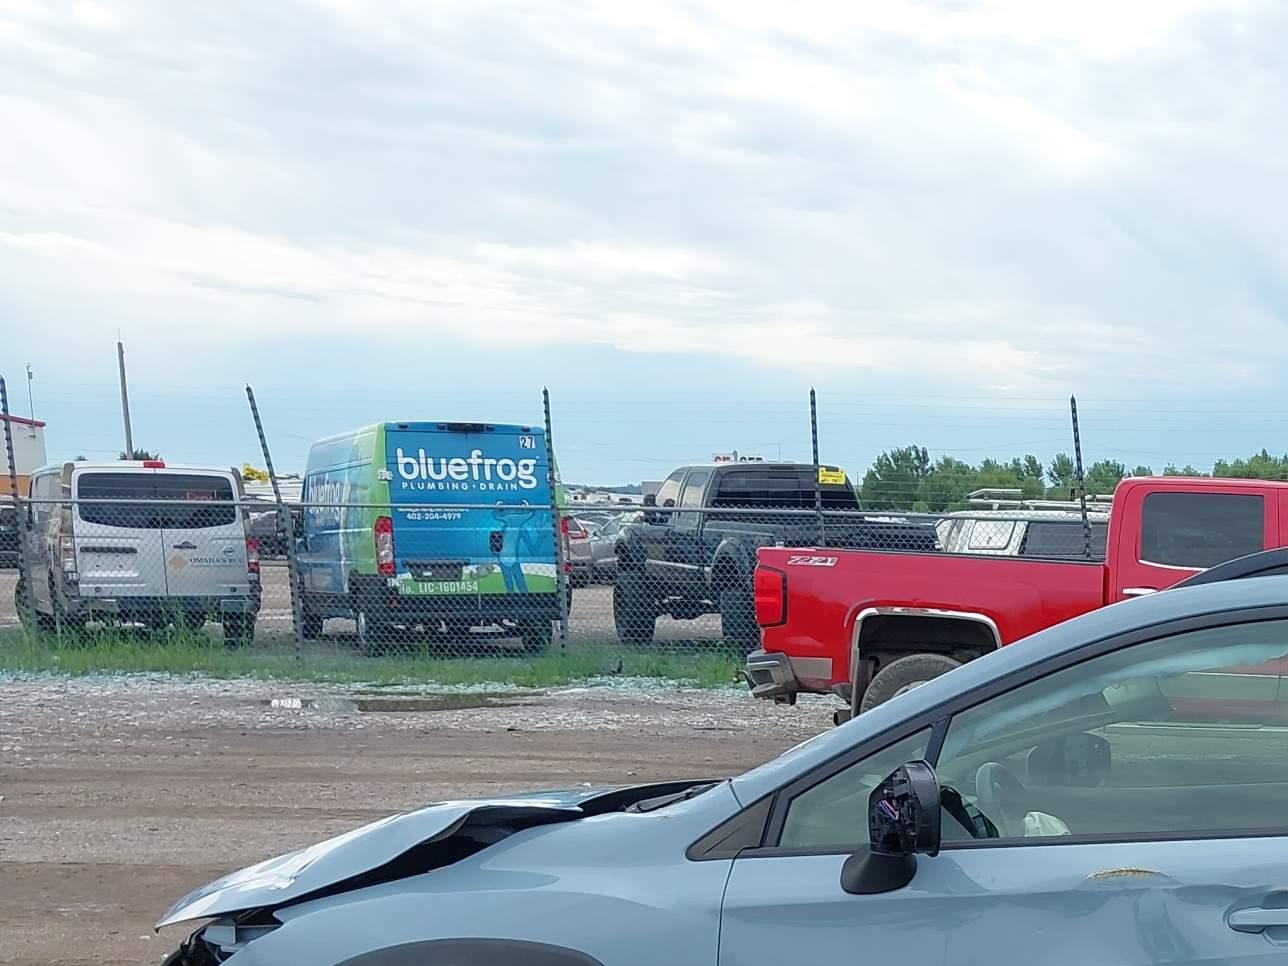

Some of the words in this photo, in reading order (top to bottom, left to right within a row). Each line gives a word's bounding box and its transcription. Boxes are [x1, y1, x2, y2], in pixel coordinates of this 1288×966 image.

[520, 437, 535, 448] 27
[396, 448, 537, 489] bluefrog
[401, 482, 469, 490] PLUMBING
[480, 482, 518, 491] DRAIN
